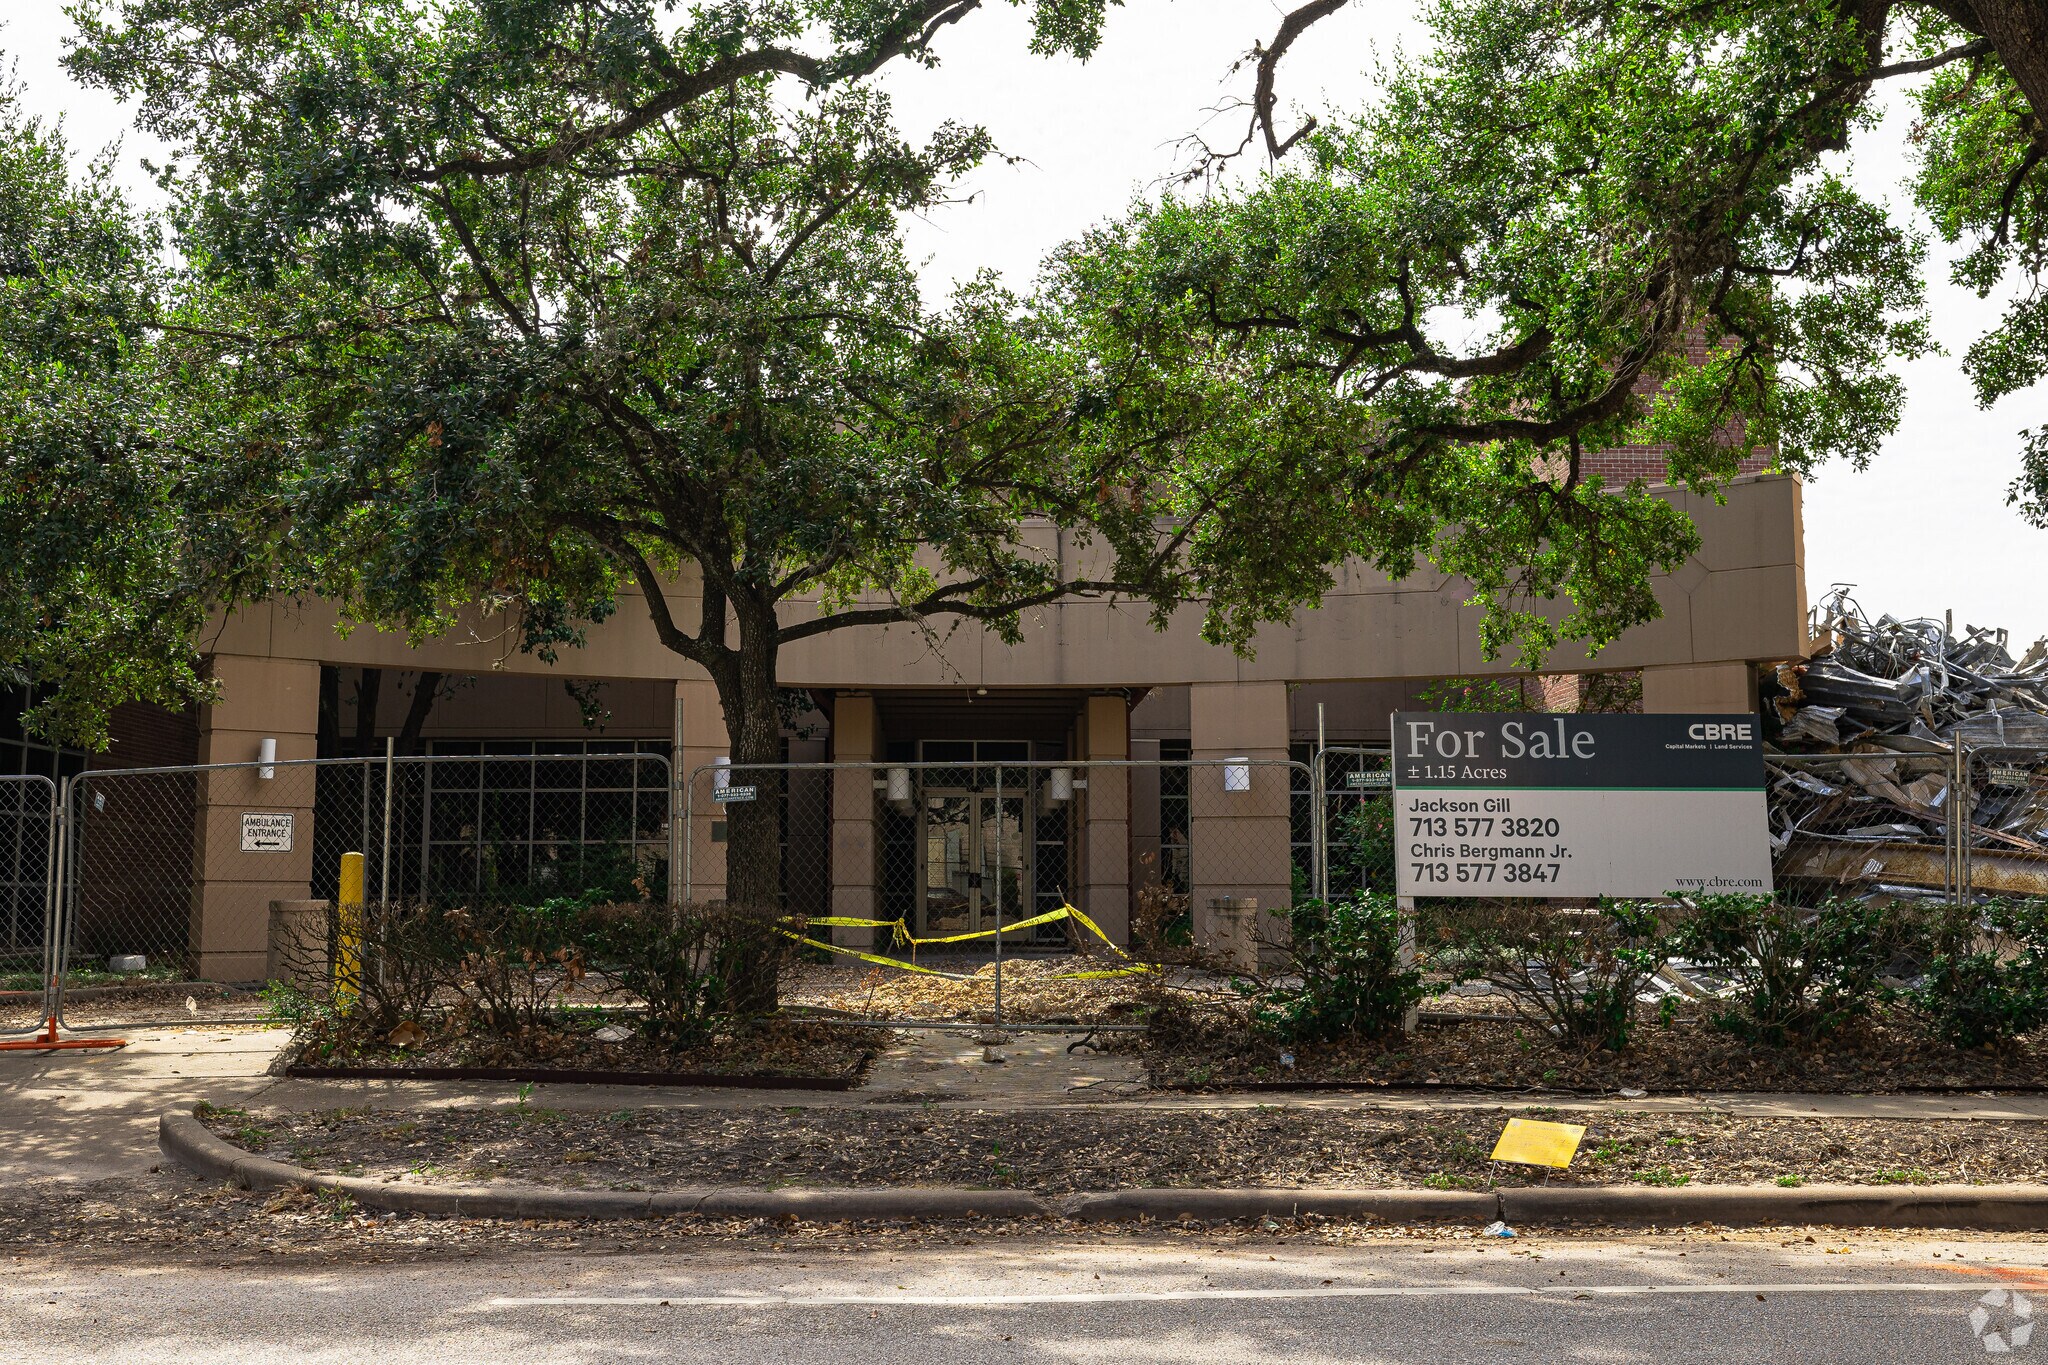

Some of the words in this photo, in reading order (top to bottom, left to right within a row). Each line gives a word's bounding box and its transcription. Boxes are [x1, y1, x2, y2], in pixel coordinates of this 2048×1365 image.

[1406, 721, 1485, 759] For
[1502, 717, 1596, 759] Sale
[1688, 723, 1753, 741] CBRE
[1425, 765, 1456, 779] 1.15
[1461, 765, 1507, 780] Acres
[715, 787, 754, 795] AMERICAN
[1409, 797, 1479, 813] Jackson
[1484, 797, 1511, 813] Gill
[244, 818, 291, 828] AMBULANCE
[1410, 818, 1448, 838] 713
[1454, 818, 1495, 838] 577
[1501, 818, 1560, 838] 3820
[247, 829, 286, 838] ENTRANCE
[1410, 843, 1455, 859] Chris
[1460, 843, 1546, 862] Bergmann
[1550, 843, 1573, 859] Jr.
[1411, 863, 1450, 883] 713
[1456, 863, 1497, 883] 577
[1503, 863, 1561, 883] 3847
[1675, 876, 1763, 889] www.cbre.com
